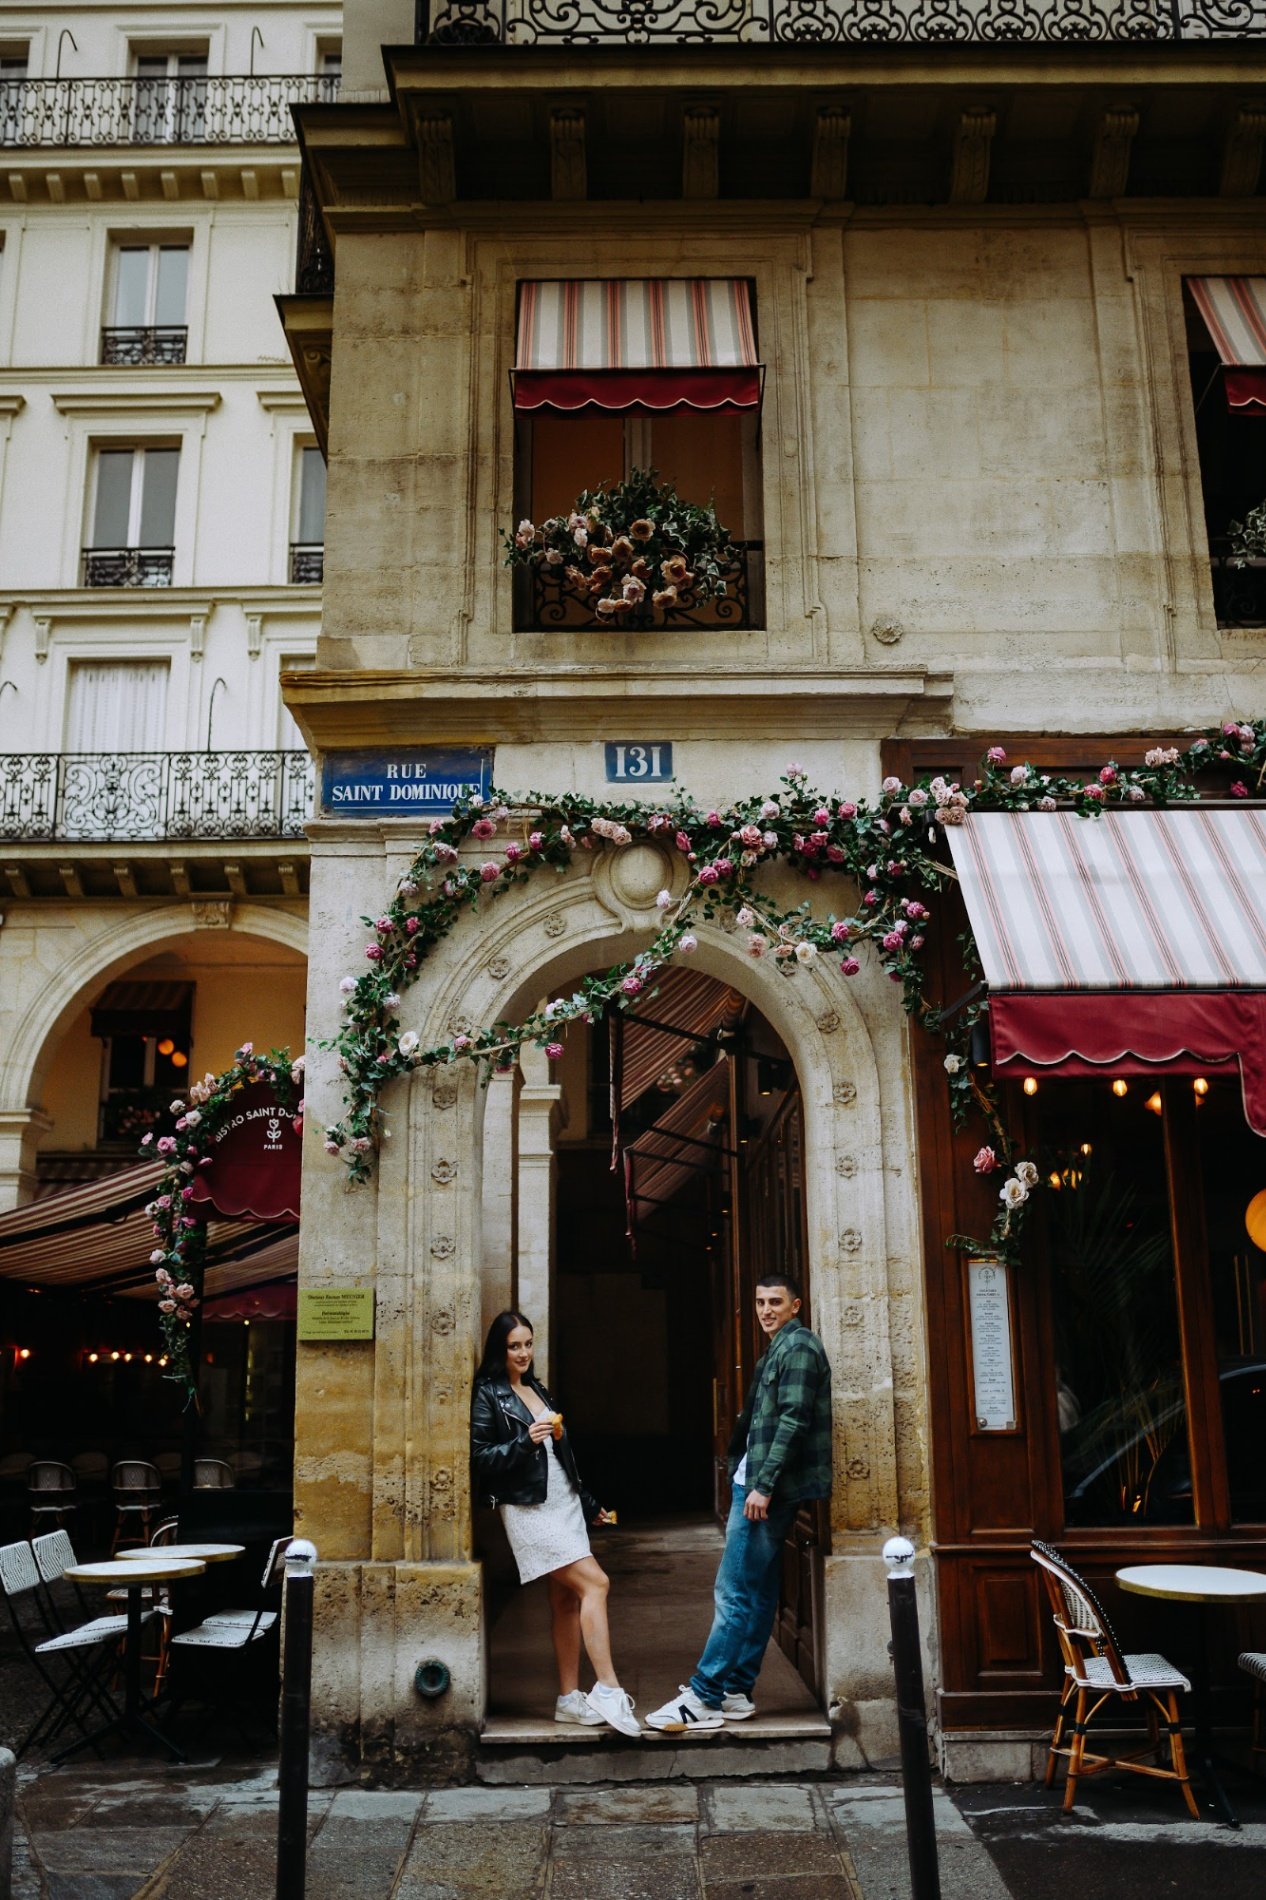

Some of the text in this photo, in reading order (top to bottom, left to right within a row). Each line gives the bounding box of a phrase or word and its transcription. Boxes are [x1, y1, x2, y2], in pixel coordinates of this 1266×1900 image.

[615, 746, 662, 777] 131
[386, 763, 427, 779] RUE
[332, 784, 383, 801] SAINT
[246, 1107, 276, 1120] SAINT
